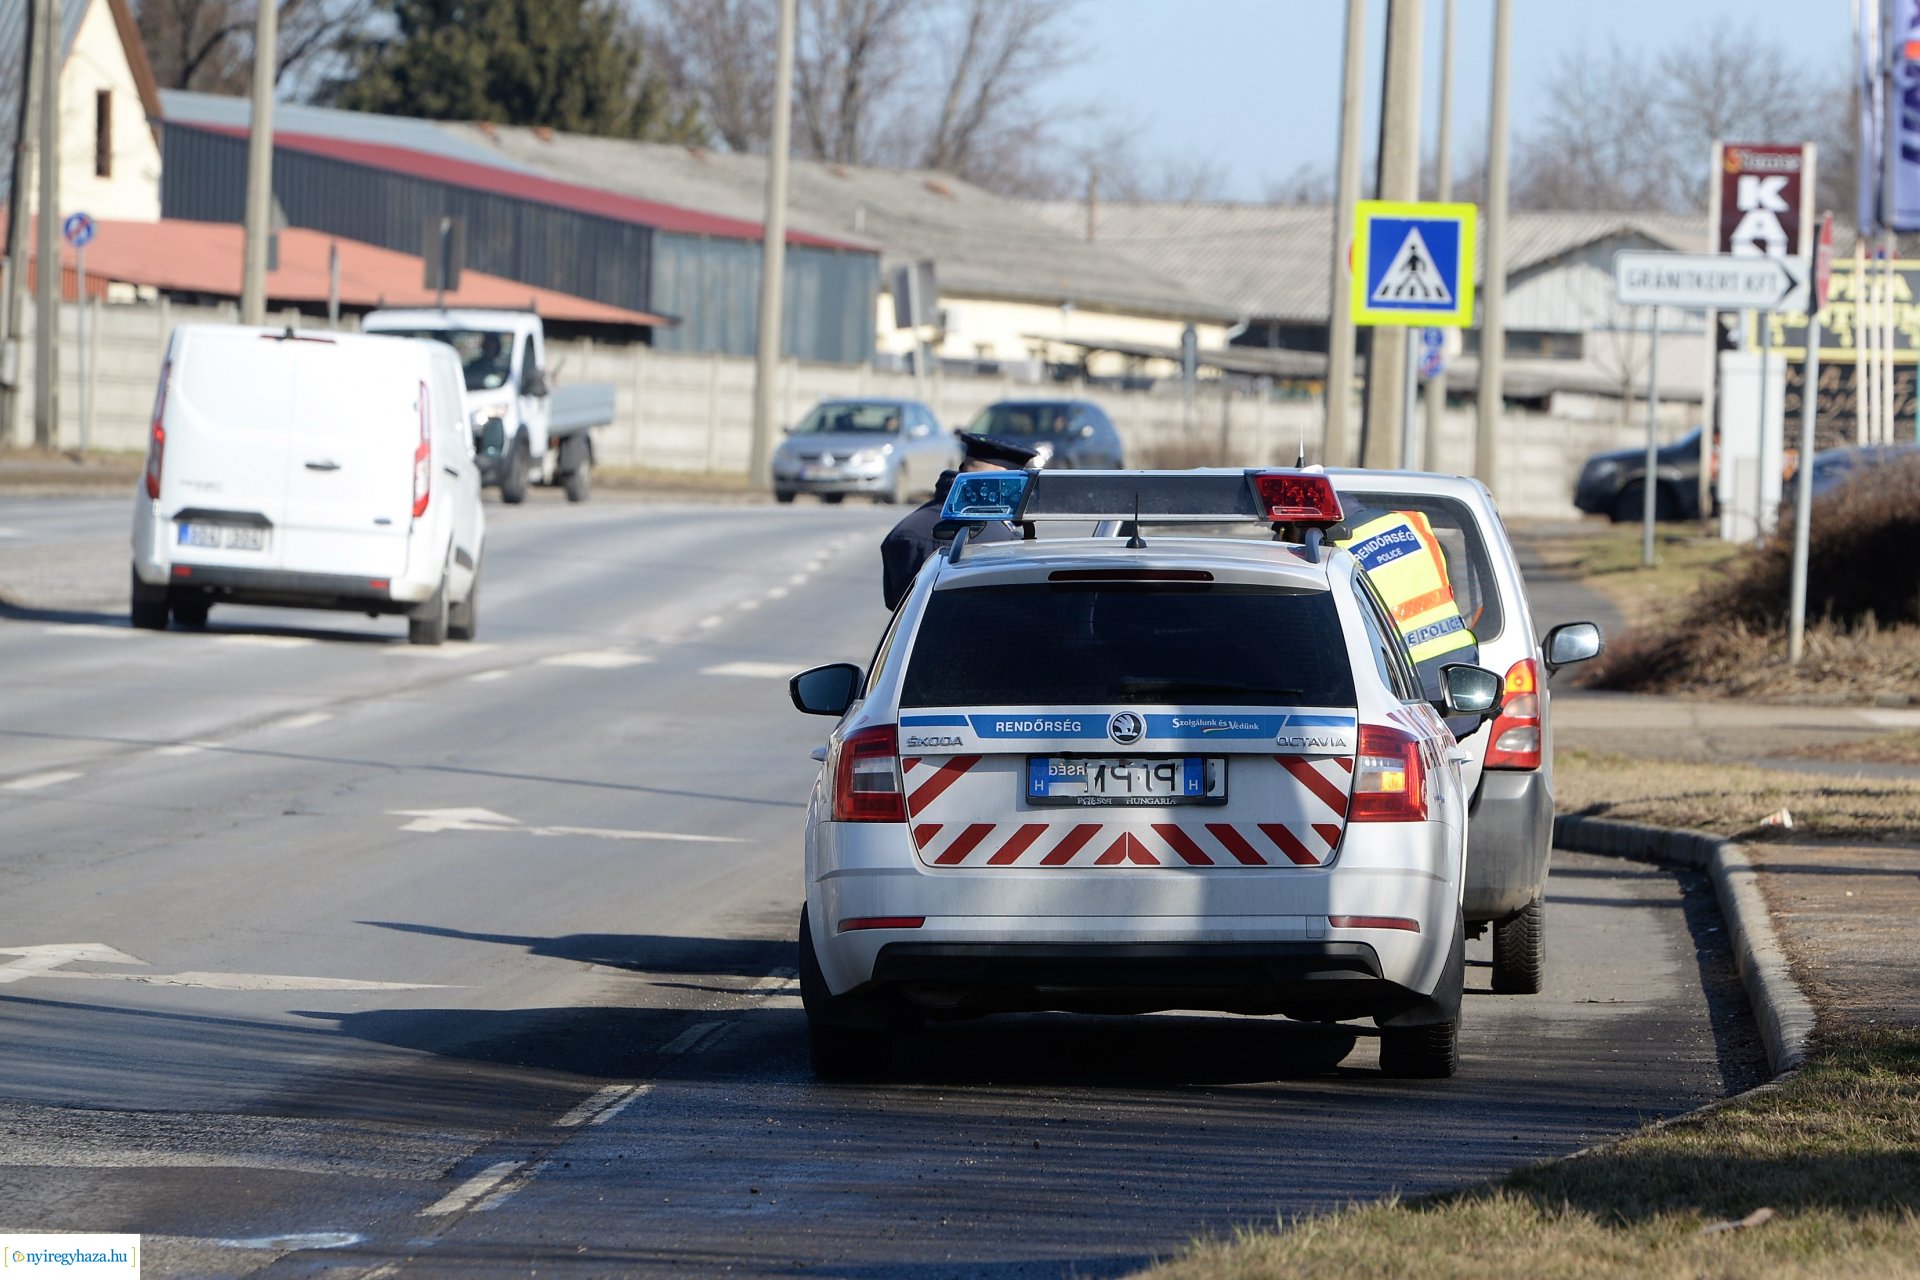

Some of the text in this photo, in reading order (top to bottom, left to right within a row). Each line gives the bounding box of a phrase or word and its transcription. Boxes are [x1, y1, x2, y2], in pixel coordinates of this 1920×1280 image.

[1354, 529, 1415, 562] RENDŐRSÉG
[1376, 547, 1403, 564] POLICE
[995, 718, 1082, 732] RENDŐRSÉG
[1172, 717, 1260, 730] Szolgálunk és Védünk
[1276, 736, 1347, 748] OCTAVIA
